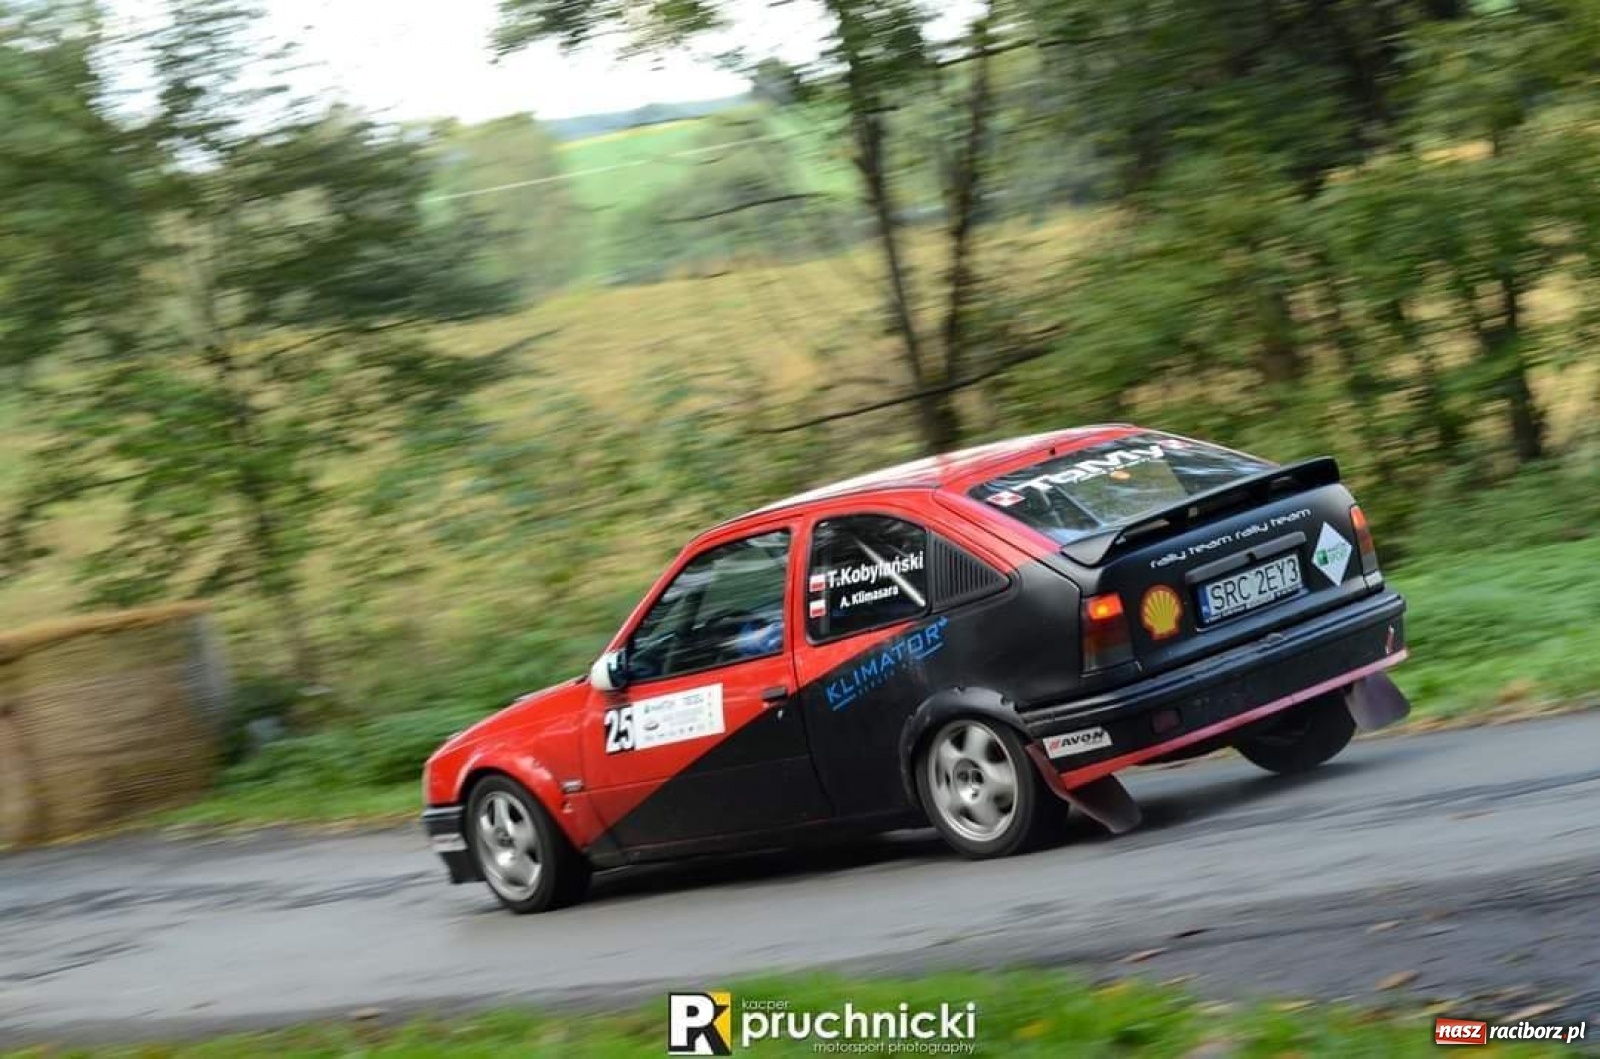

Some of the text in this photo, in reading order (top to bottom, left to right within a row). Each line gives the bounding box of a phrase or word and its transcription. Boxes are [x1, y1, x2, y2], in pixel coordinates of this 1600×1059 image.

[1150, 508, 1312, 568] rally team rally team
[852, 585, 899, 605] Klimasara
[1210, 575, 1250, 611] SRC
[1256, 556, 1299, 596] 2EY3
[826, 623, 943, 703] KLIMATOR
[604, 706, 634, 754] 25
[1061, 729, 1105, 748] AVON
